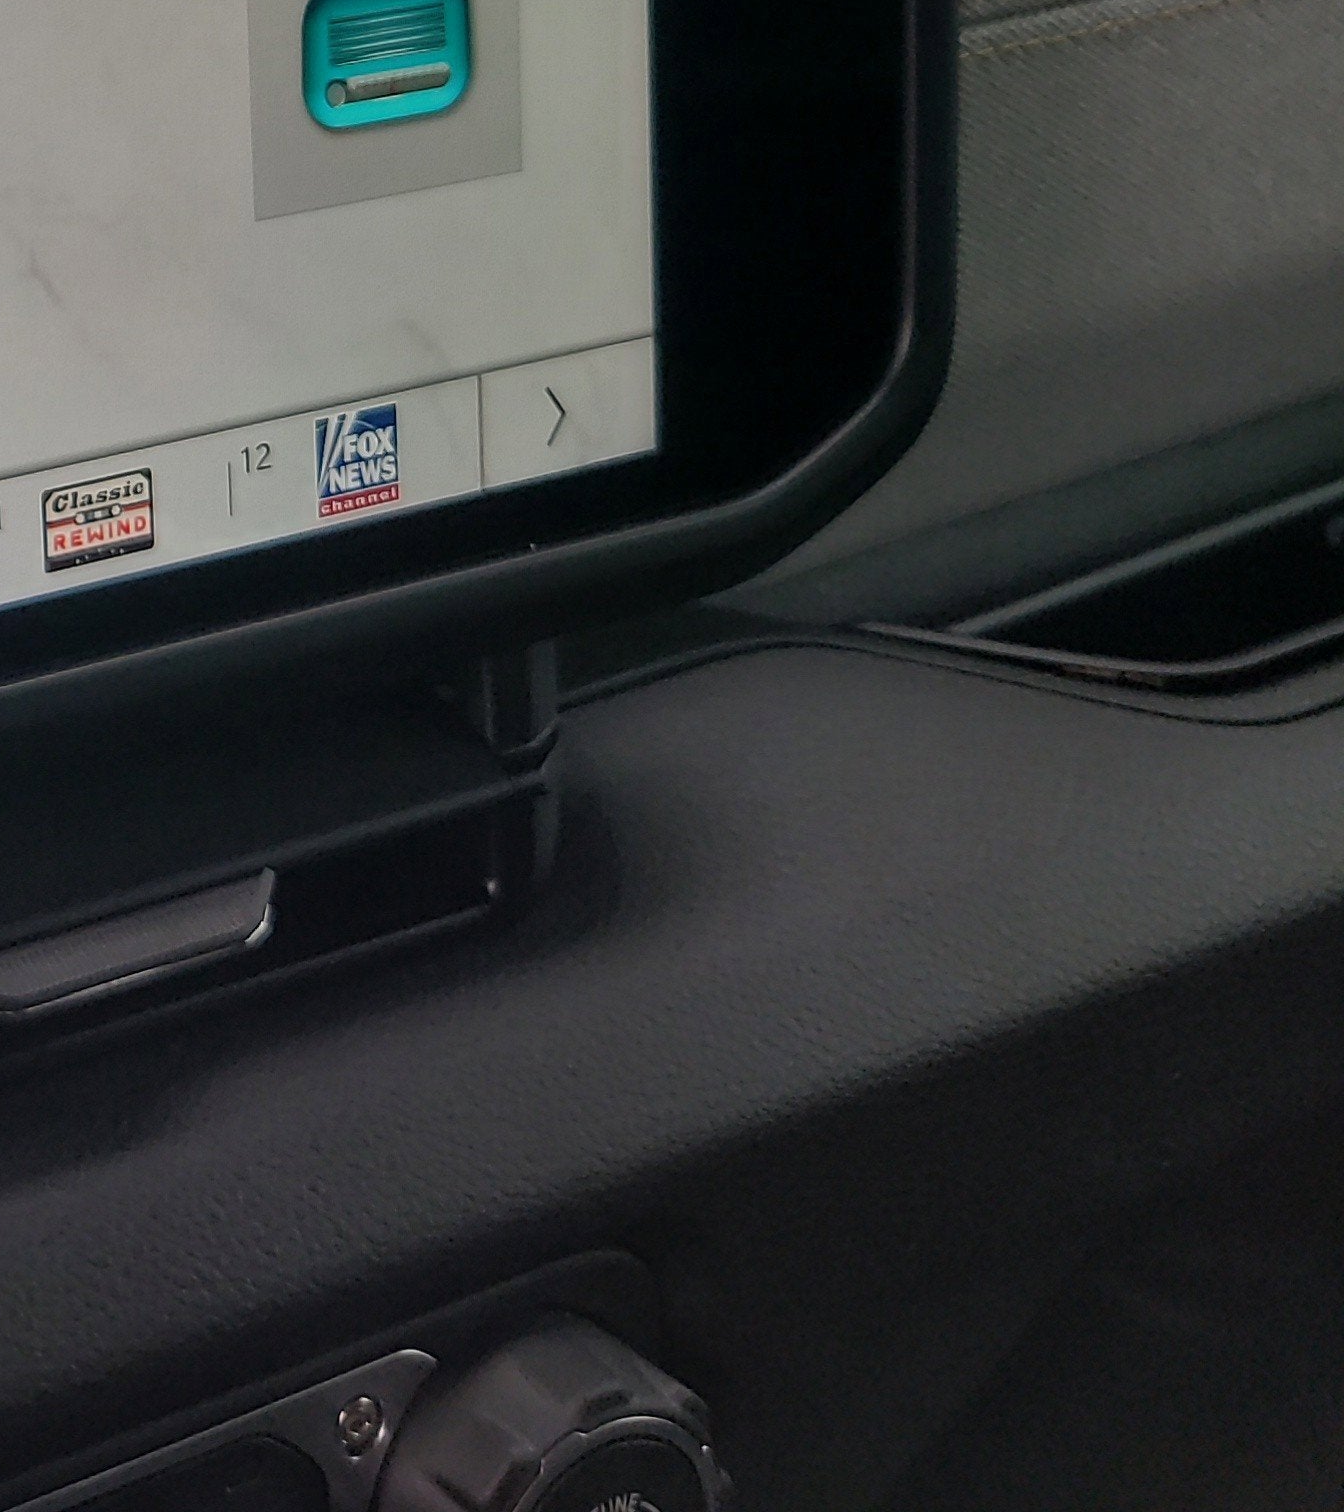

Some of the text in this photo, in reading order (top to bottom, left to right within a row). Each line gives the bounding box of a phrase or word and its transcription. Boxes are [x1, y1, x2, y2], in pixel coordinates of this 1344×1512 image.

[241, 442, 272, 475] 12
[342, 425, 396, 462] FOX
[328, 456, 397, 494] NEWS
[50, 478, 145, 514] Classic
[320, 486, 399, 516] channel
[52, 514, 148, 552] REWIND
